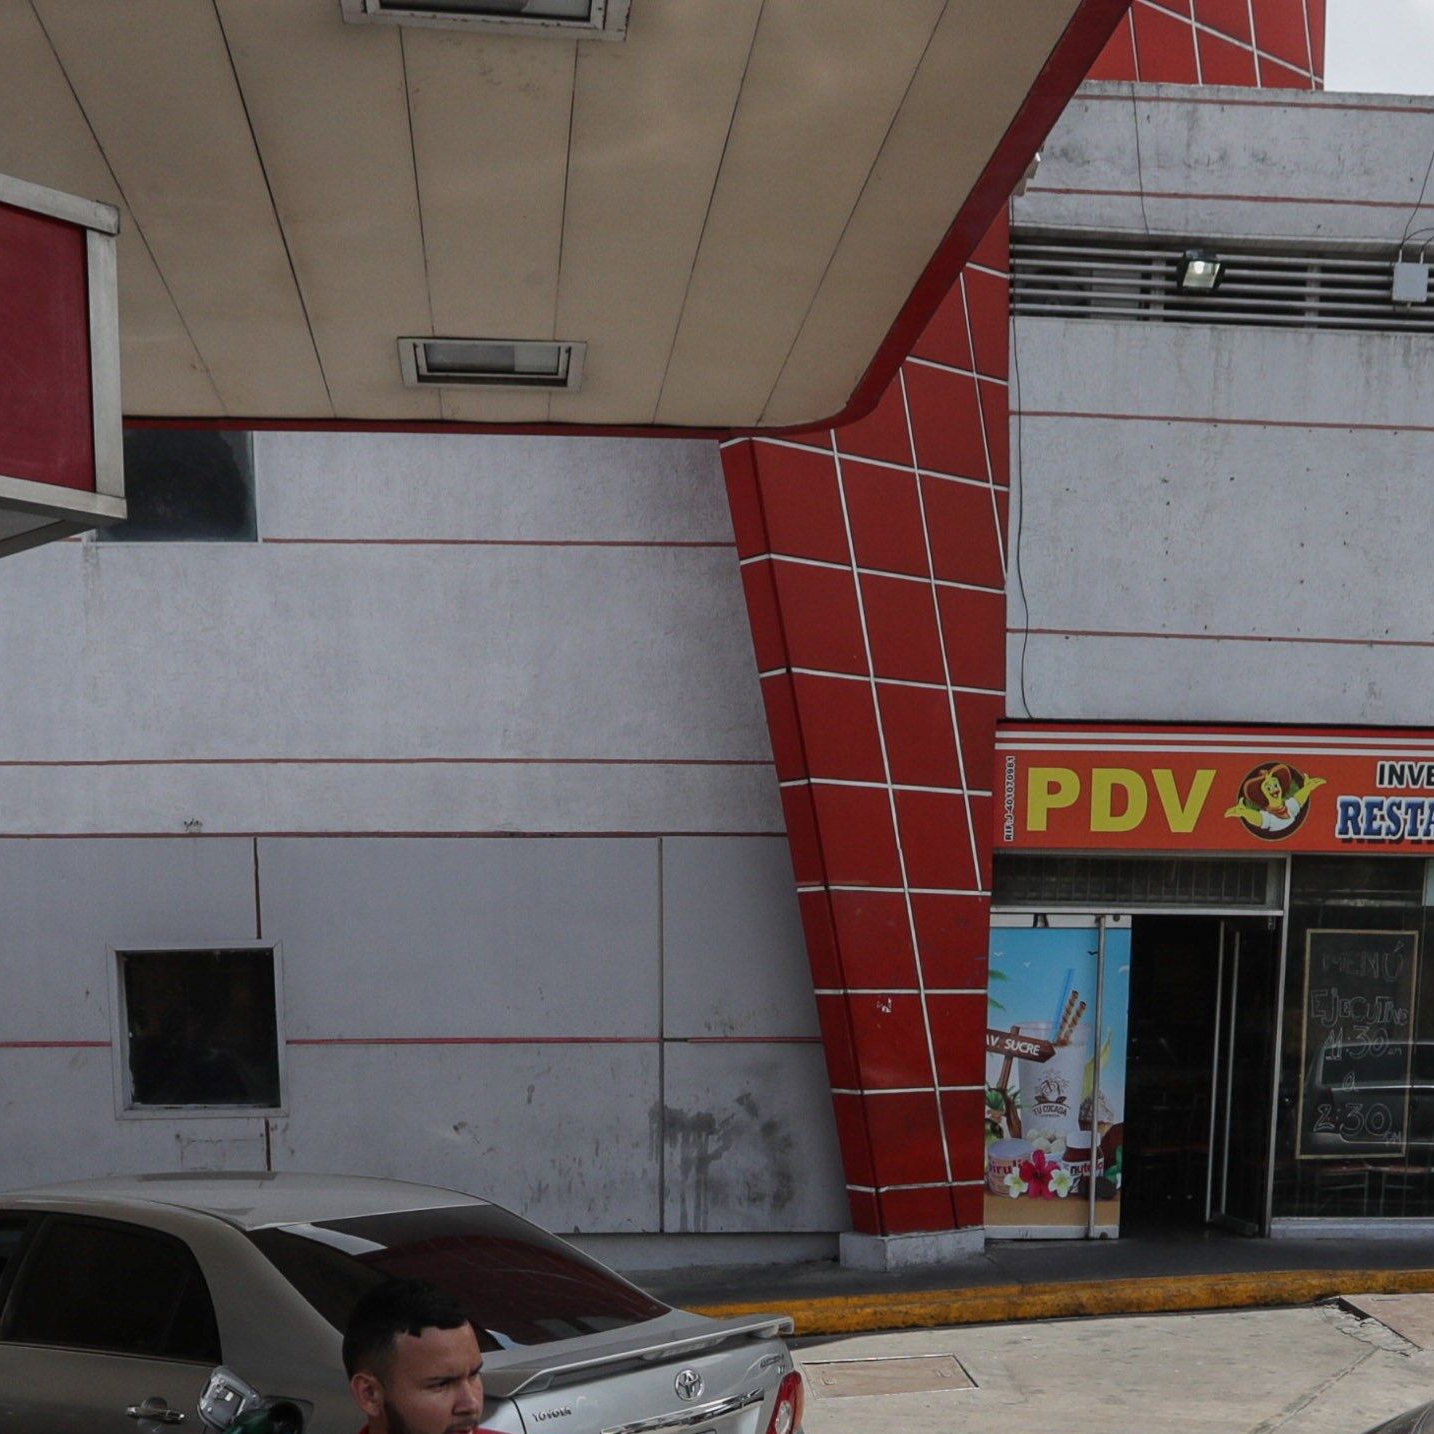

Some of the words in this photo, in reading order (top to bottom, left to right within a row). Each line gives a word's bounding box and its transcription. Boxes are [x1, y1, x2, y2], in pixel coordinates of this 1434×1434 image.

[1027, 767, 1217, 833] PDV
[1004, 1039, 1040, 1056] SUCRE
[1313, 1103, 1392, 1136] 2:30
[532, 1406, 572, 1422] TOYOTA
